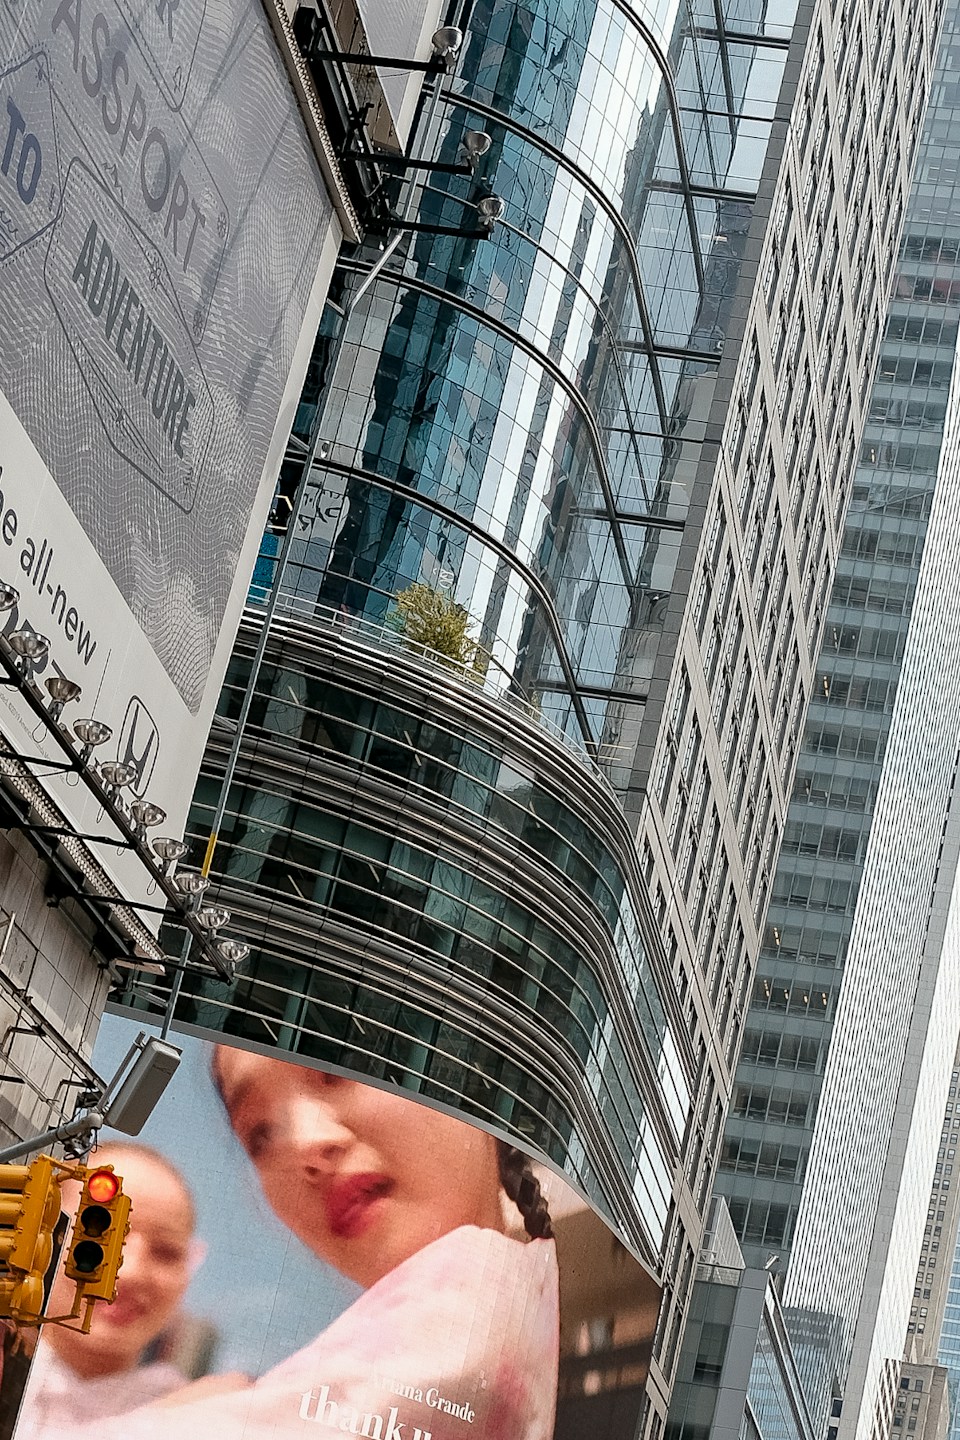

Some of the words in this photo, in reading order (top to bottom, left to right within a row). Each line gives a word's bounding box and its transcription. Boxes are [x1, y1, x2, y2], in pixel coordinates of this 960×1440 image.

[0, 96, 42, 205] TO
[73, 219, 196, 460] ADVENTURE
[20, 537, 98, 666] all-new
[425, 1387, 475, 1424] Grande
